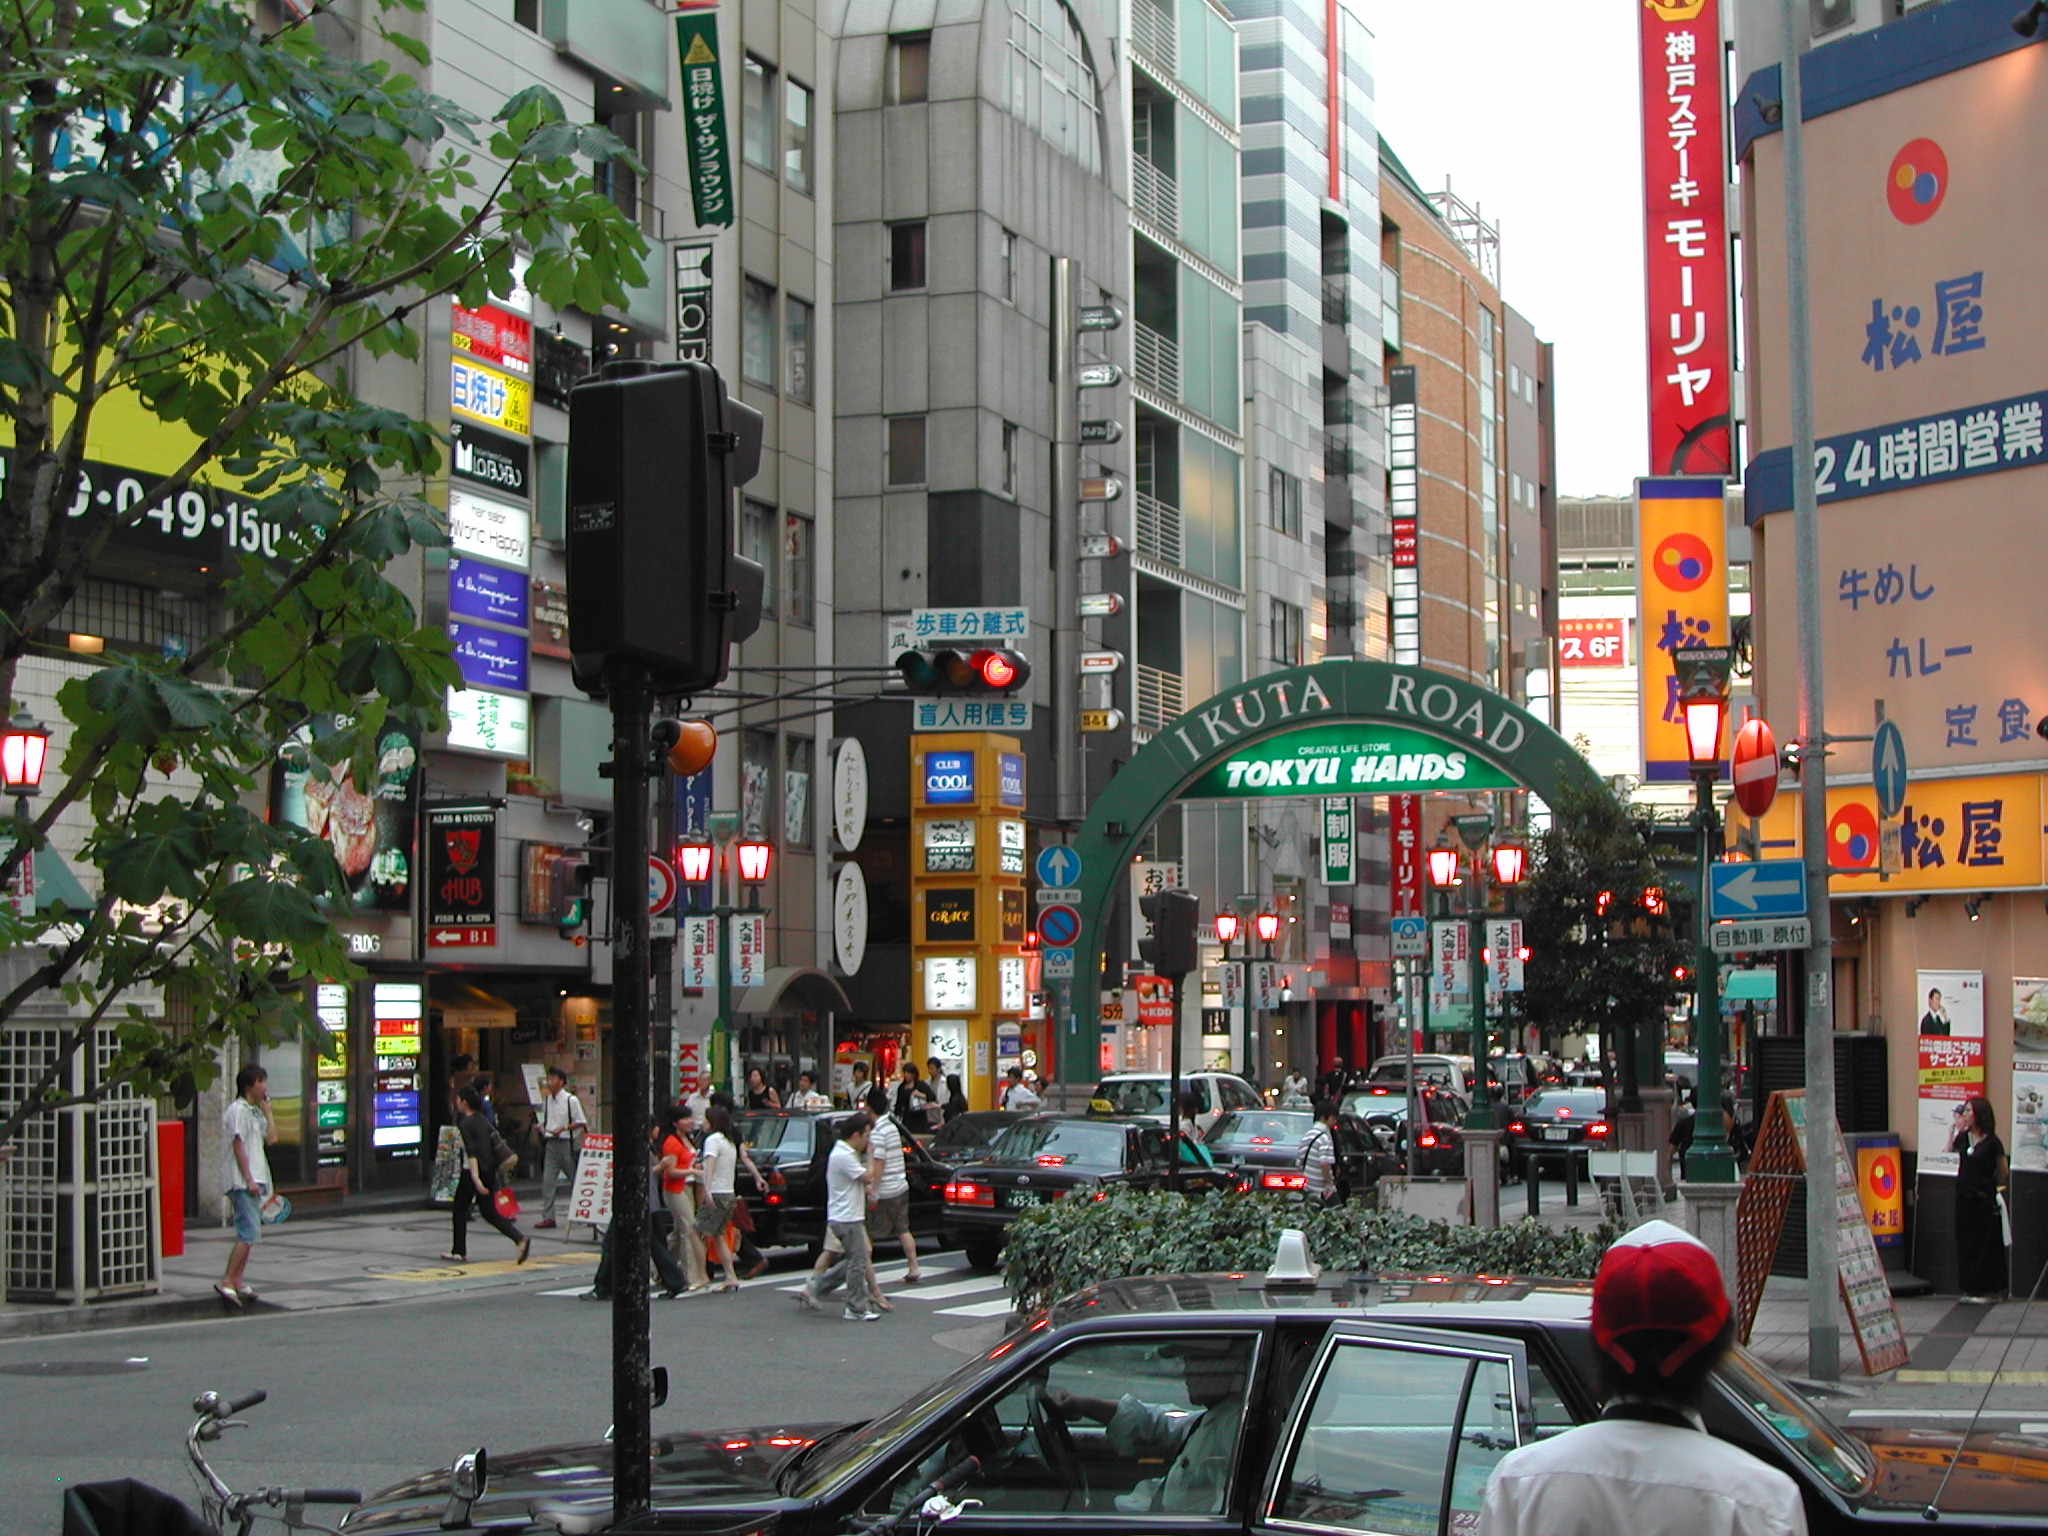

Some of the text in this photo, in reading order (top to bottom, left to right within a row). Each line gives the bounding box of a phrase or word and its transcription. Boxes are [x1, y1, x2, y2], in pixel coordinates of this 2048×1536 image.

[689, 67, 715, 110] 日焼け
[1665, 31, 1700, 207] 神戸ステーキ
[1665, 219, 1711, 406] モーリヤ
[1861, 271, 1986, 372] 松屋
[453, 363, 507, 418] 日焼け
[1814, 401, 2044, 495] 24時間営業
[453, 517, 526, 557] World Happy
[1839, 563, 1935, 610] 牛めし
[915, 612, 1025, 637] 歩車分離式
[1589, 636, 1620, 658] 6F
[1886, 637, 1973, 678] カレー
[918, 703, 1028, 726] 盲人用信号
[1174, 674, 1525, 762] IKUTA ROAD
[1946, 697, 2031, 747] 定食
[935, 760, 961, 770] CLUB
[1298, 743, 1391, 755] CREATIVE LIFE STORE
[927, 775, 972, 788] COOL
[1225, 752, 1467, 788] TOKYU HANDS
[432, 815, 454, 824] ALES
[463, 814, 494, 823] STOUTS
[1901, 800, 2004, 869] 松屋
[441, 878, 484, 906] HUB
[435, 915, 454, 923] FISH
[466, 914, 491, 922] CHIPS
[353, 935, 381, 952] BLDG
